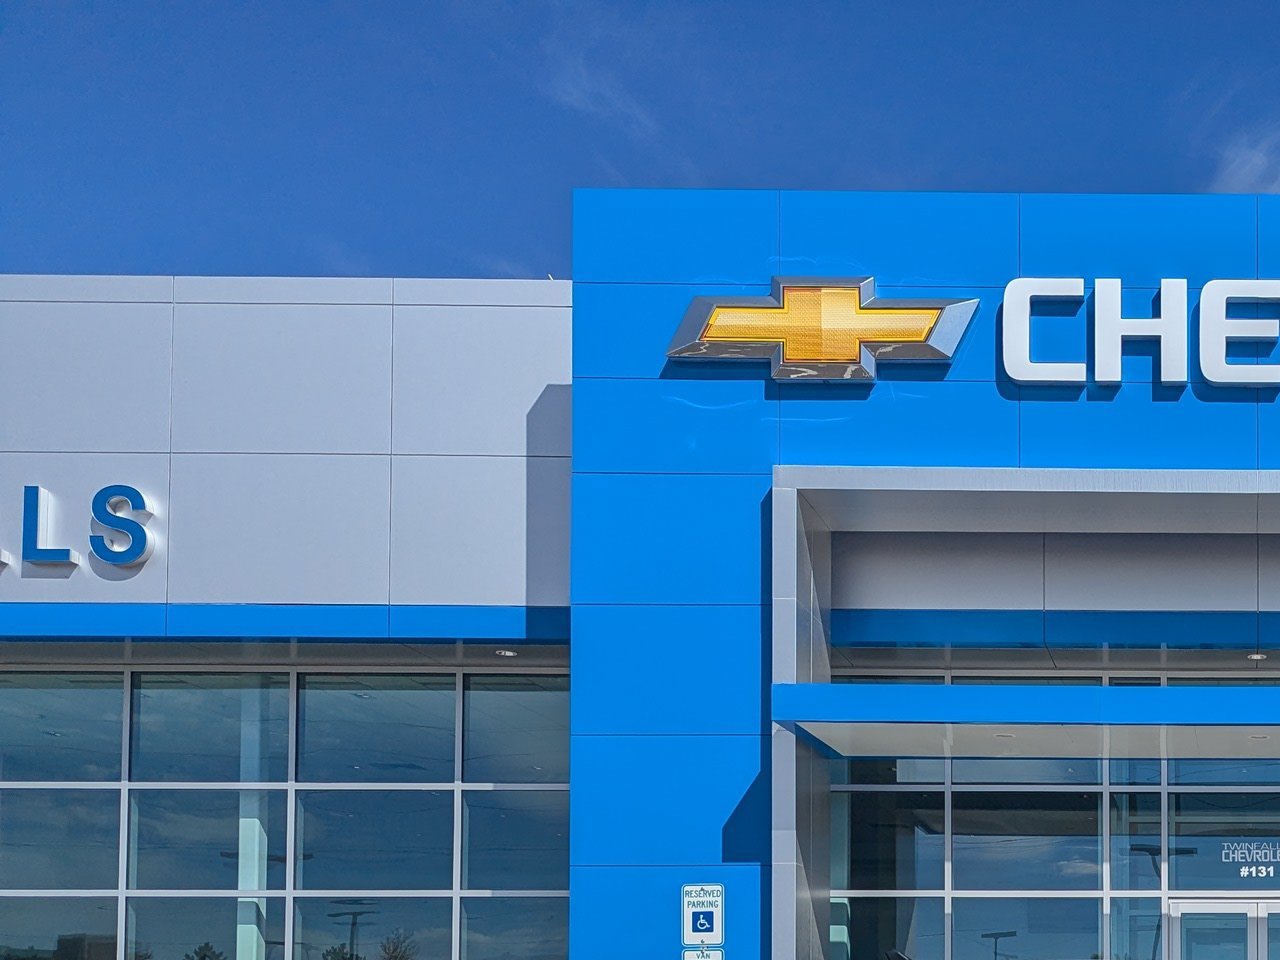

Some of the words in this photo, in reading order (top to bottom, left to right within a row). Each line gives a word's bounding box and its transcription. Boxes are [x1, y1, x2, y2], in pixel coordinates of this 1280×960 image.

[22, 484, 152, 566] LS
[1239, 866, 1275, 877] #131
[684, 889, 721, 898] RESERVED
[687, 900, 719, 909] PARKING
